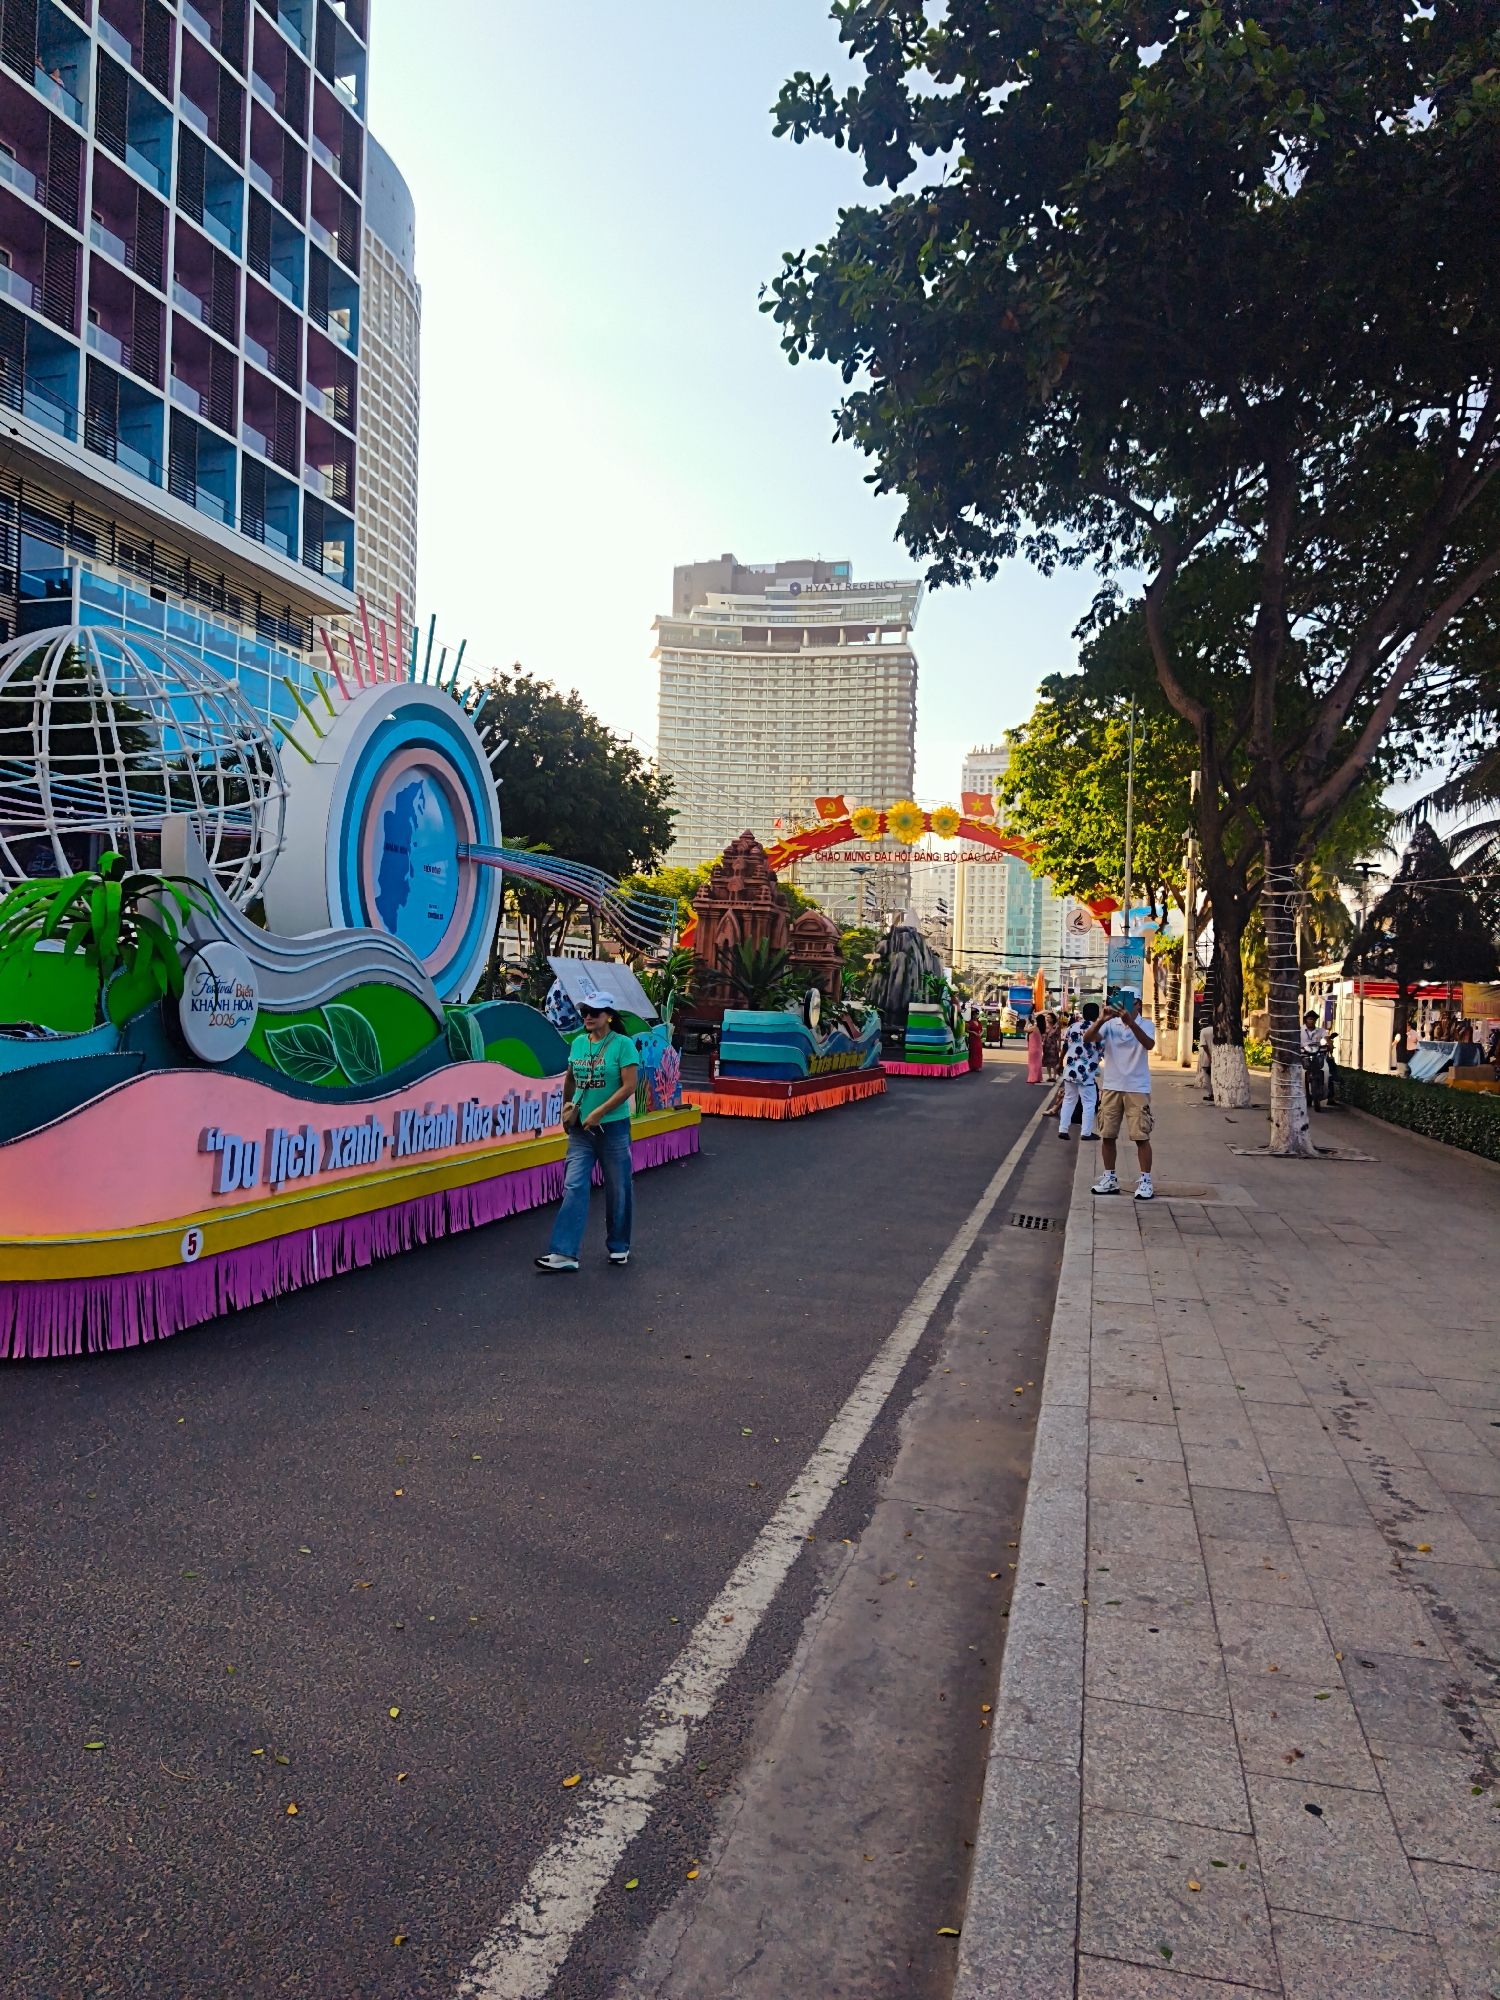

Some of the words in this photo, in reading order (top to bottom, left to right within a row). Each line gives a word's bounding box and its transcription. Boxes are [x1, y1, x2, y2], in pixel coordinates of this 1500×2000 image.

[806, 582, 841, 593] HYATT
[846, 580, 898, 591] REGENCY
[874, 851, 891, 863] ĐẠI
[894, 849, 911, 863] HỘI
[914, 848, 940, 862] ĐẢNG
[961, 849, 980, 862] CÁC
[27, 858, 83, 872] ISLAD
[191, 997, 230, 1012] KHÁNH
[233, 997, 254, 1011] HÒA
[209, 1012, 235, 1027] 2026
[267, 1125, 320, 1191] lịch
[324, 1114, 384, 1170] xanh
[395, 1102, 457, 1157] Khánh
[188, 1232, 197, 1256] 5
